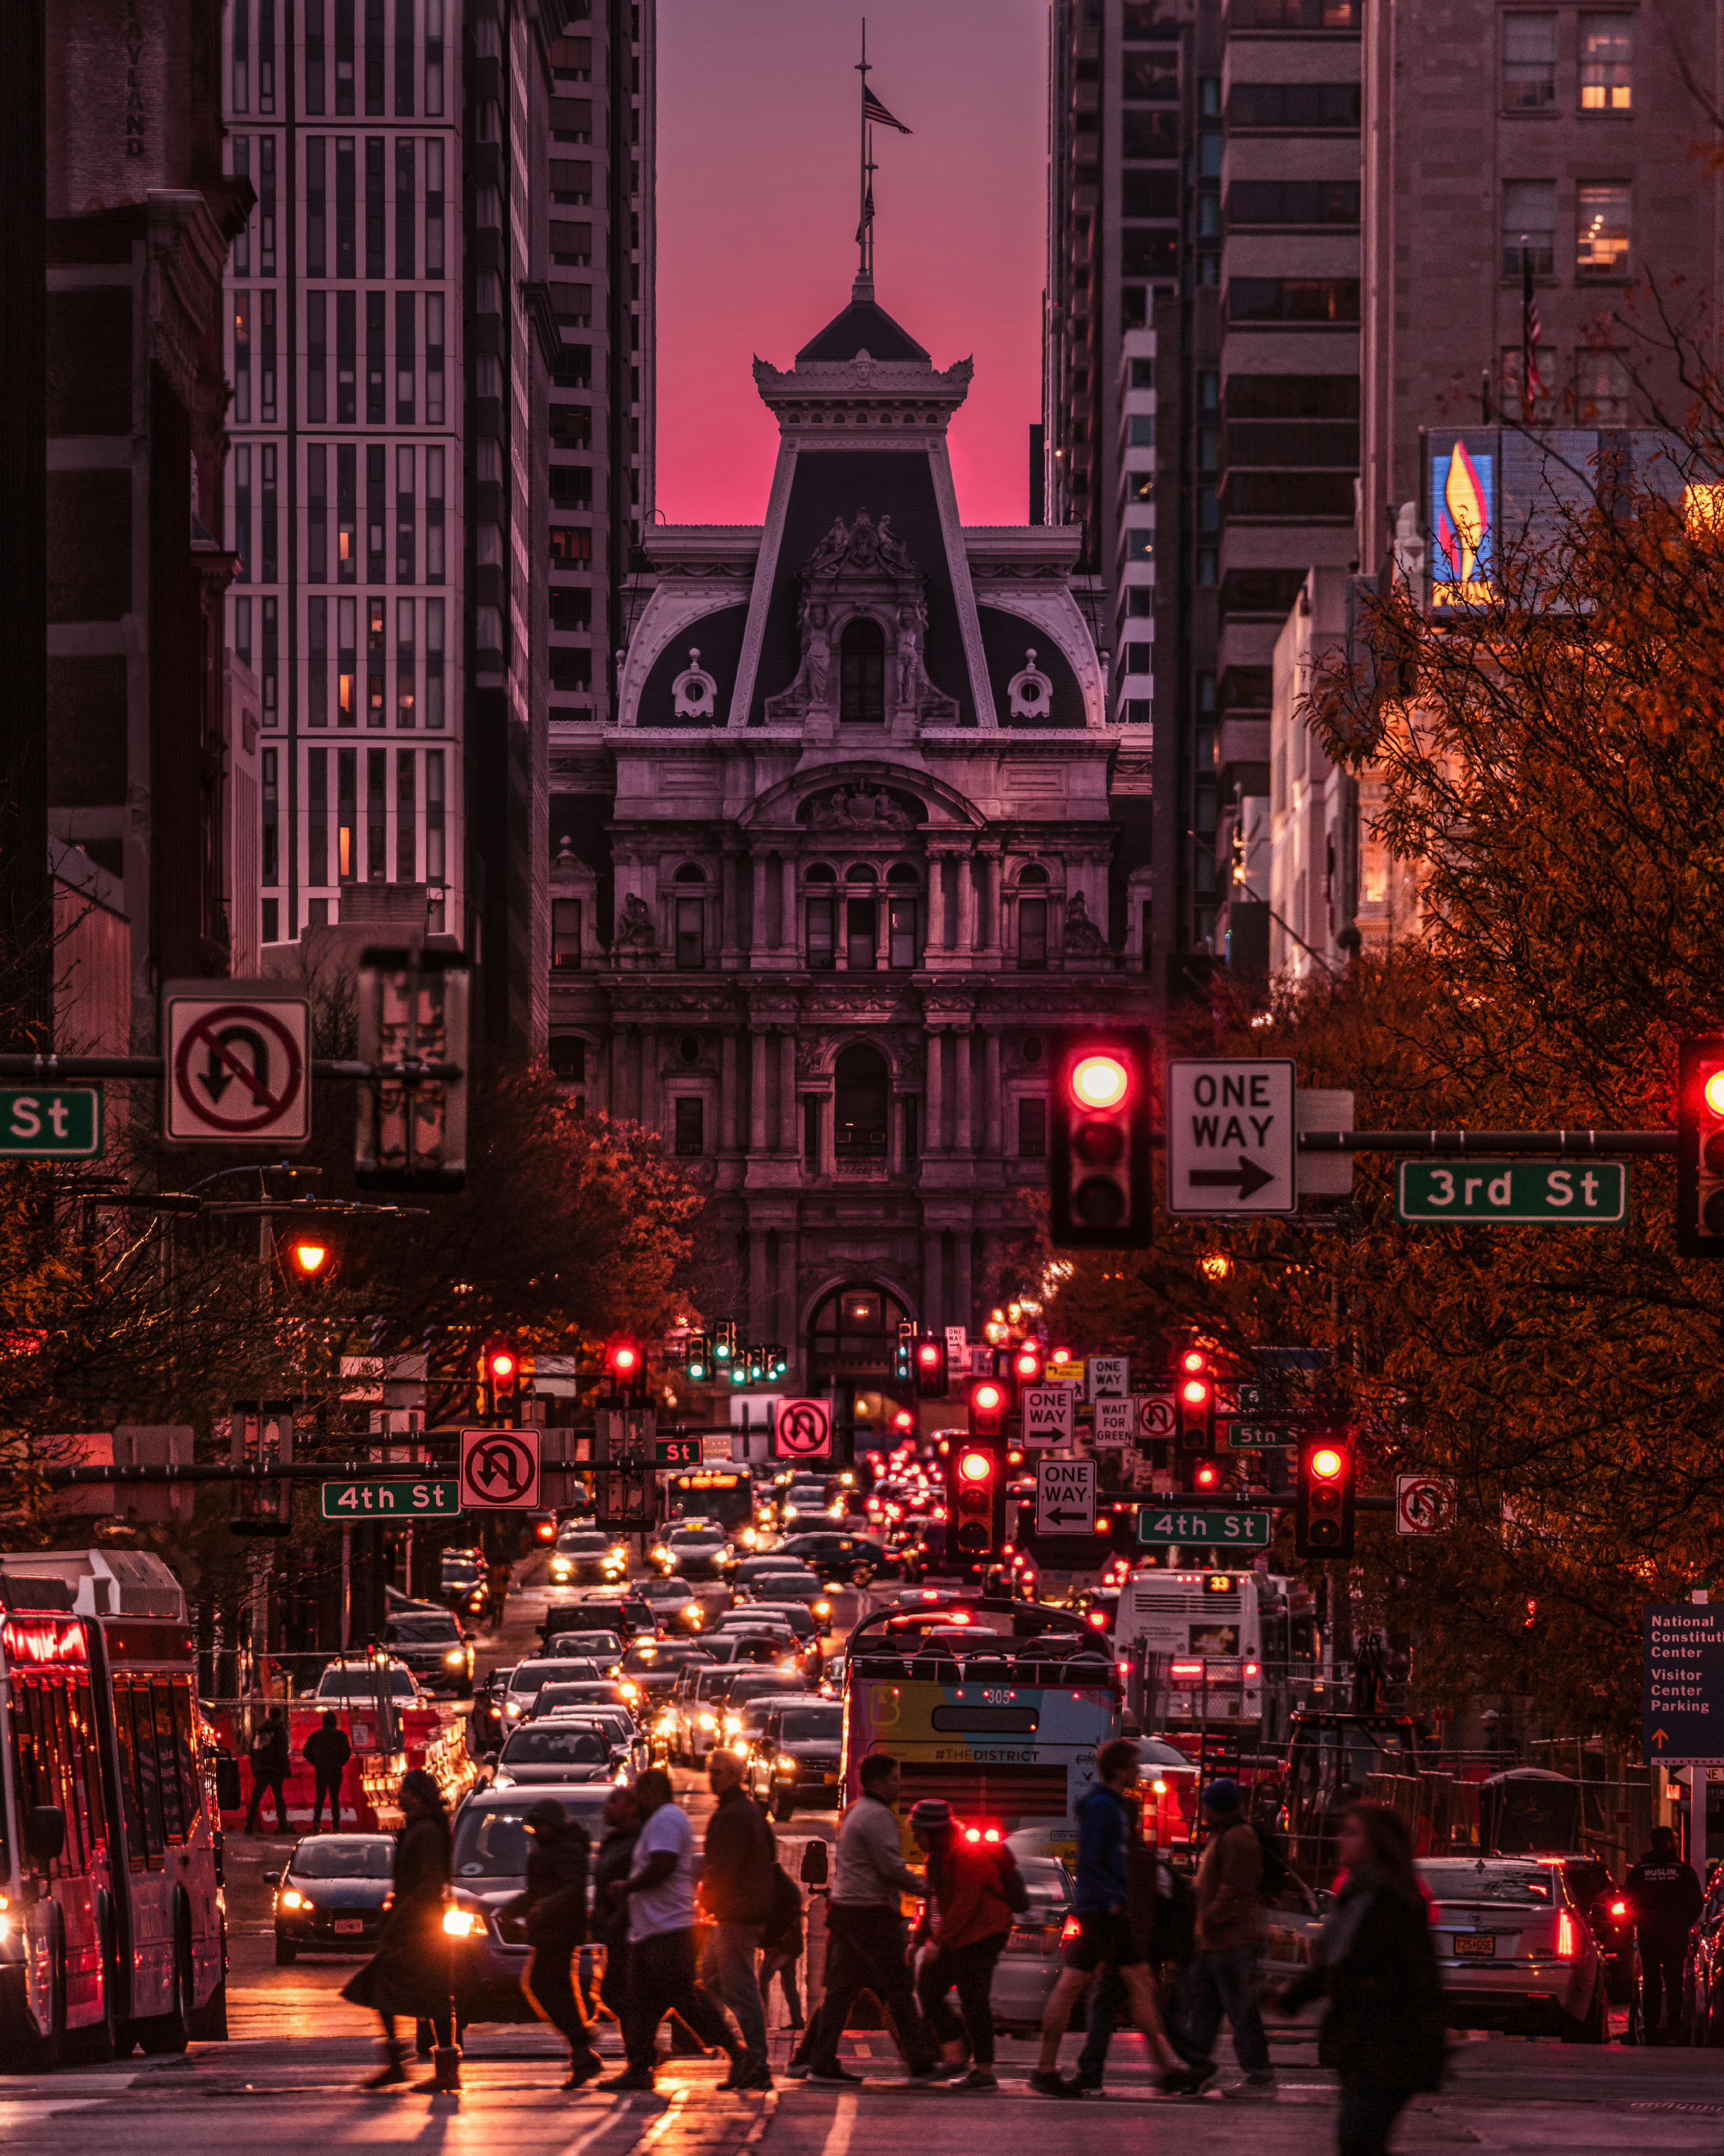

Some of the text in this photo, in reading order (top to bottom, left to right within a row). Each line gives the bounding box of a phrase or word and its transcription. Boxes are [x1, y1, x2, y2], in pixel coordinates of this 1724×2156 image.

[1195, 1075, 1270, 1107] ONE
[9, 1097, 69, 1138] St
[1192, 1115, 1274, 1147] WAY
[1427, 1169, 1599, 1207] 3rd St
[1096, 1361, 1120, 1371] ONE
[1096, 1374, 1121, 1384] WAY
[1030, 1394, 1066, 1406] ONE
[1102, 1405, 1127, 1414] WAIT
[1030, 1410, 1066, 1423] WAY
[1104, 1417, 1125, 1427] FOR
[1097, 1431, 1132, 1440] GREEN
[1240, 1428, 1276, 1443] 5th
[666, 1444, 690, 1461] St
[1045, 1467, 1088, 1482] ONE
[337, 1485, 445, 1509] 4th St
[1045, 1486, 1087, 1501] WAY
[1154, 1514, 1255, 1537] 4th St
[1210, 1576, 1230, 1592] 33
[1651, 1615, 1714, 1627] National
[1651, 1646, 1703, 1658] Center
[1651, 1668, 1703, 1681] Visitor
[988, 1689, 1010, 1704] 305
[1651, 1685, 1703, 1696] Center
[1651, 1700, 1710, 1714] Parking
[936, 1749, 1039, 1761] #THEDISTRICT
[1706, 1769, 1719, 1780] NE
[1644, 1869, 1679, 1877] MUSLIM,
